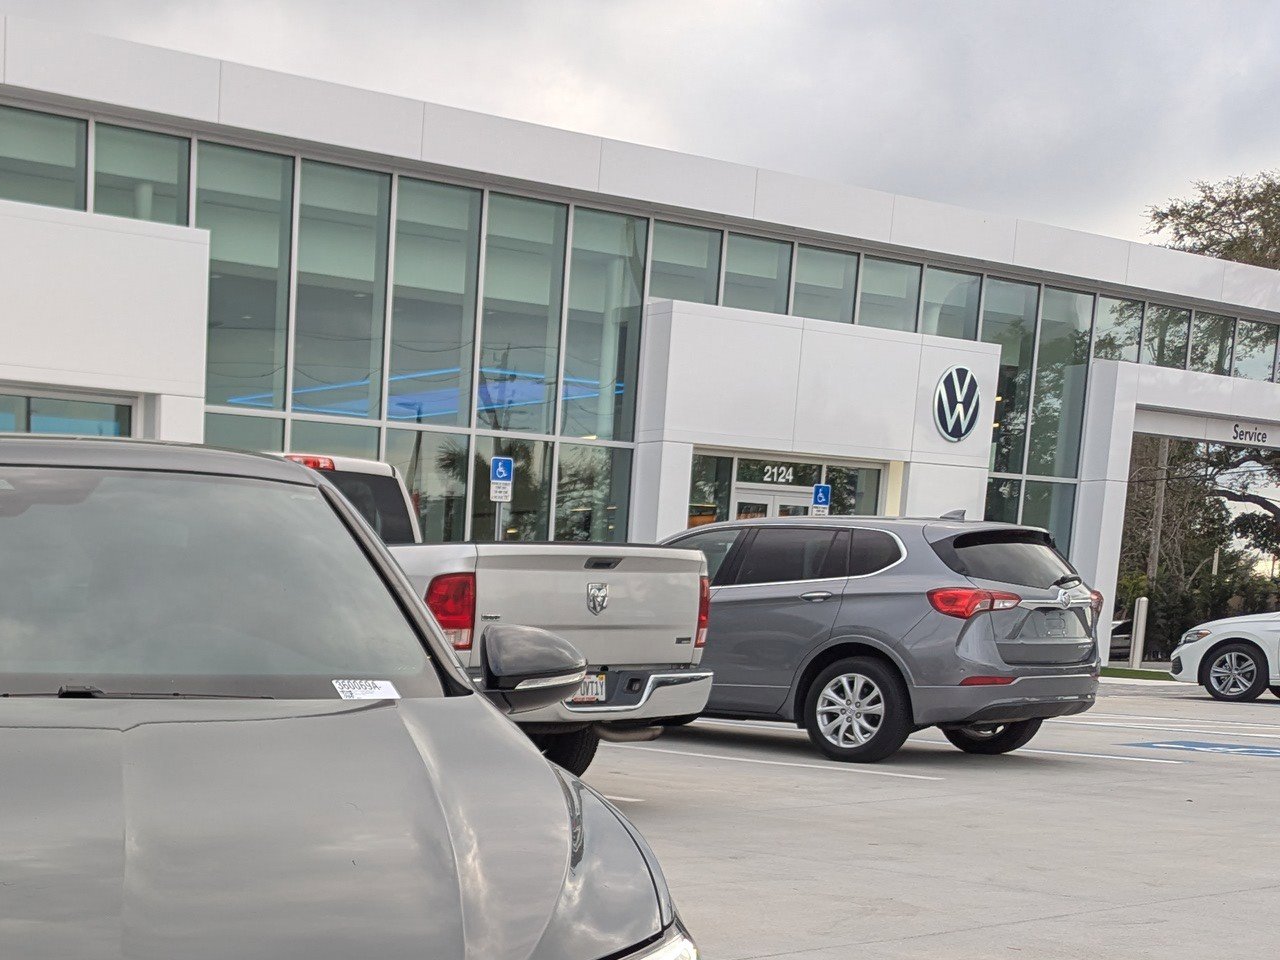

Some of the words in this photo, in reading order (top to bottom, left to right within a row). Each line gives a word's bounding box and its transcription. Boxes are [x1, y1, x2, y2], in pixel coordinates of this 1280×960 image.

[933, 365, 980, 442] VW
[1232, 423, 1267, 443] Service
[763, 465, 794, 483] 2124
